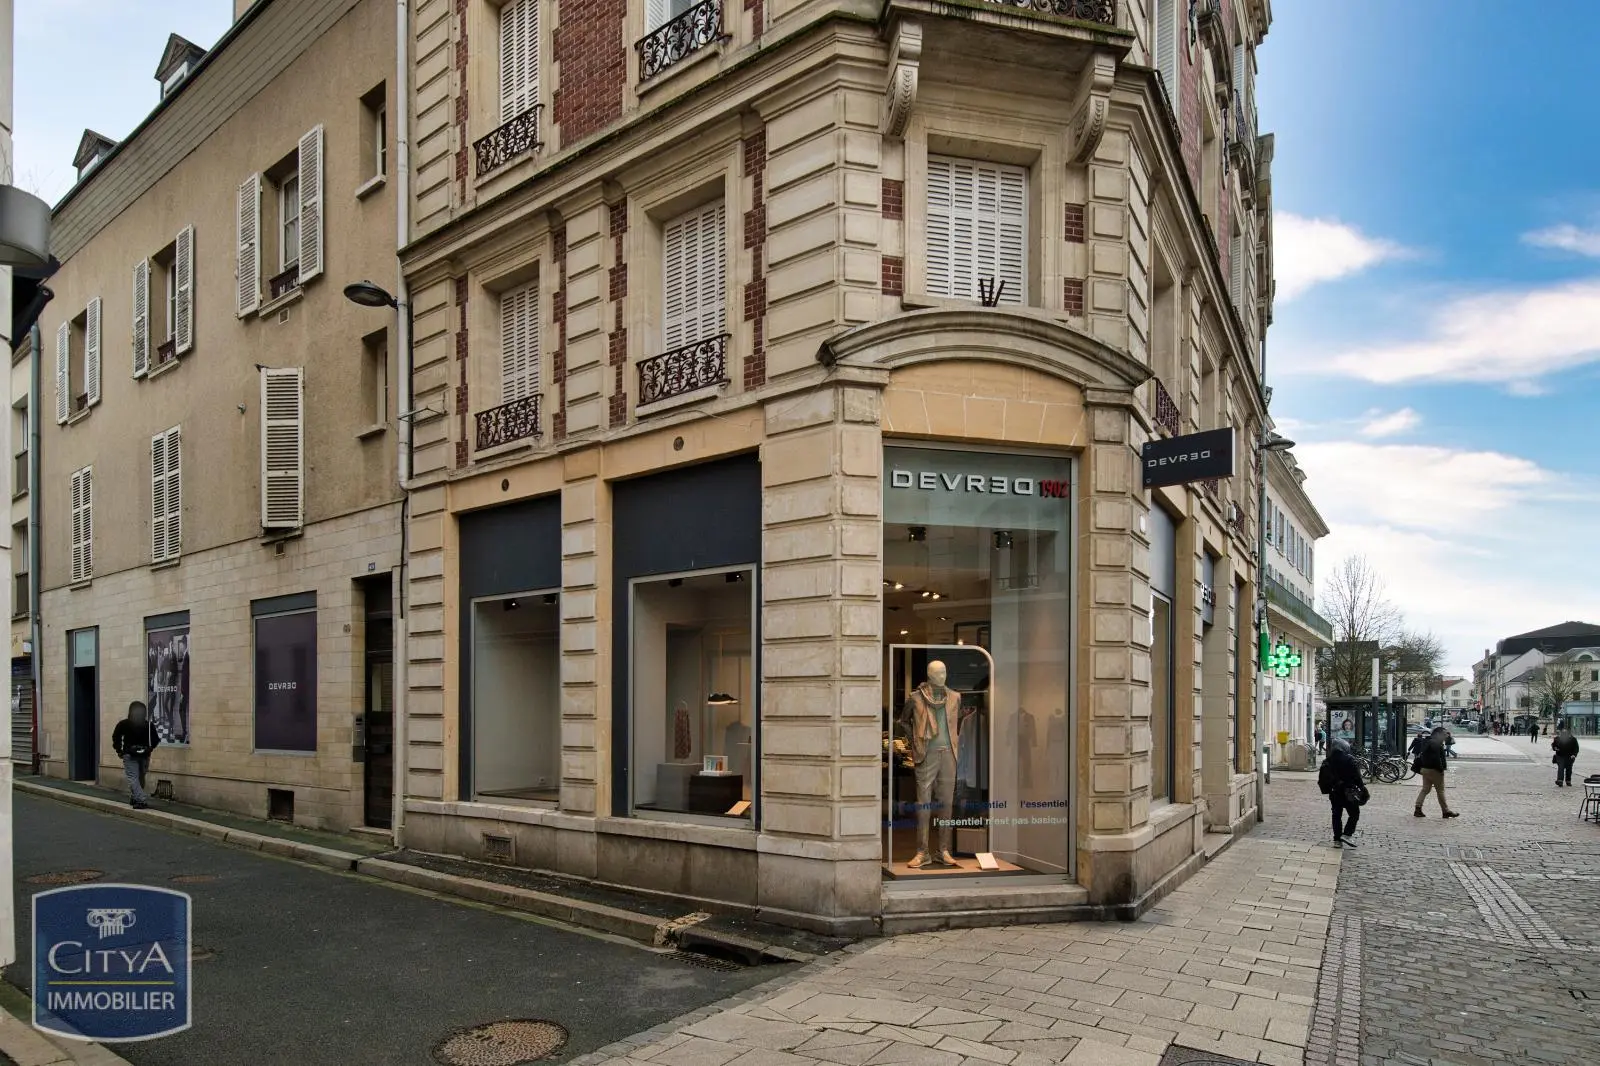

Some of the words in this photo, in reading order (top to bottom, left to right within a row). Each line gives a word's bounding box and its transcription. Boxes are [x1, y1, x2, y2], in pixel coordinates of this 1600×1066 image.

[1148, 450, 1211, 467] DEVRED
[891, 469, 1034, 495] DEVRED
[268, 682, 297, 690] DEVRED
[1020, 799, 1068, 808] l'essentiel
[933, 817, 983, 827] l'essentiel
